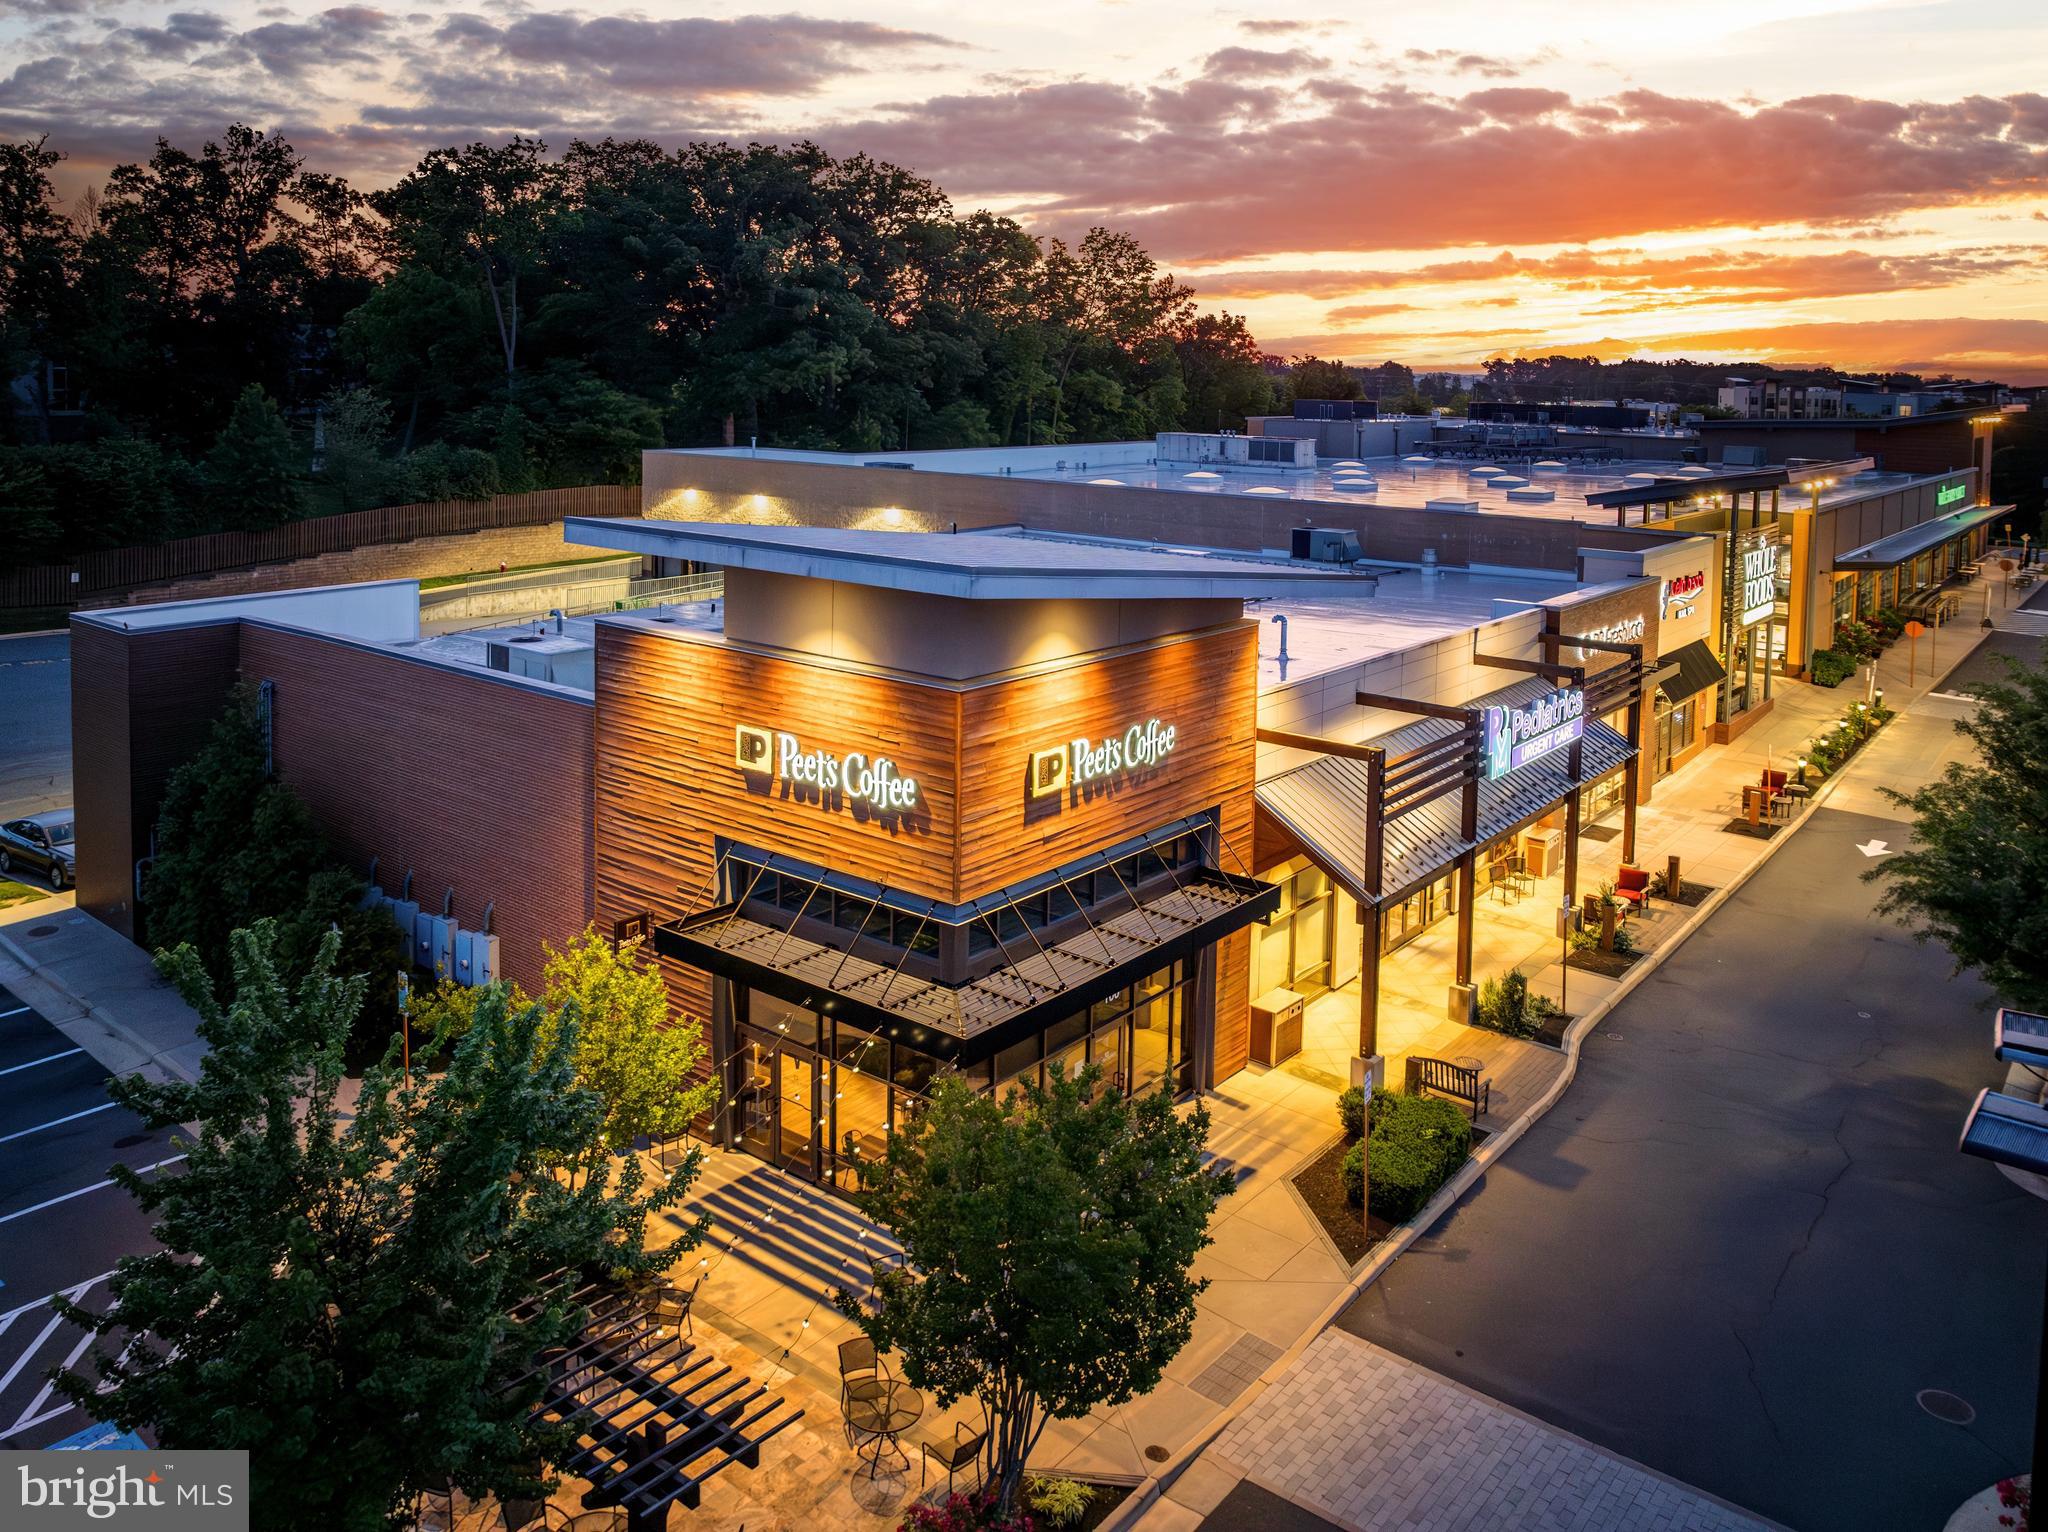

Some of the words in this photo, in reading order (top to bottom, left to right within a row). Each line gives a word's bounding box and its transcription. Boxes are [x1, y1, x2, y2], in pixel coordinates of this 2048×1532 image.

[1744, 546, 1777, 582] WHOLE
[1744, 573, 1774, 611] FOODS
[1512, 689, 1583, 744] Pediatrics
[1072, 738, 1122, 784] Peet's
[1124, 718, 1176, 767] Coffee
[1521, 735, 1554, 760] URGENT
[1554, 724, 1574, 747] CARE
[777, 733, 838, 788] Peet's
[843, 752, 916, 808] Coffee
